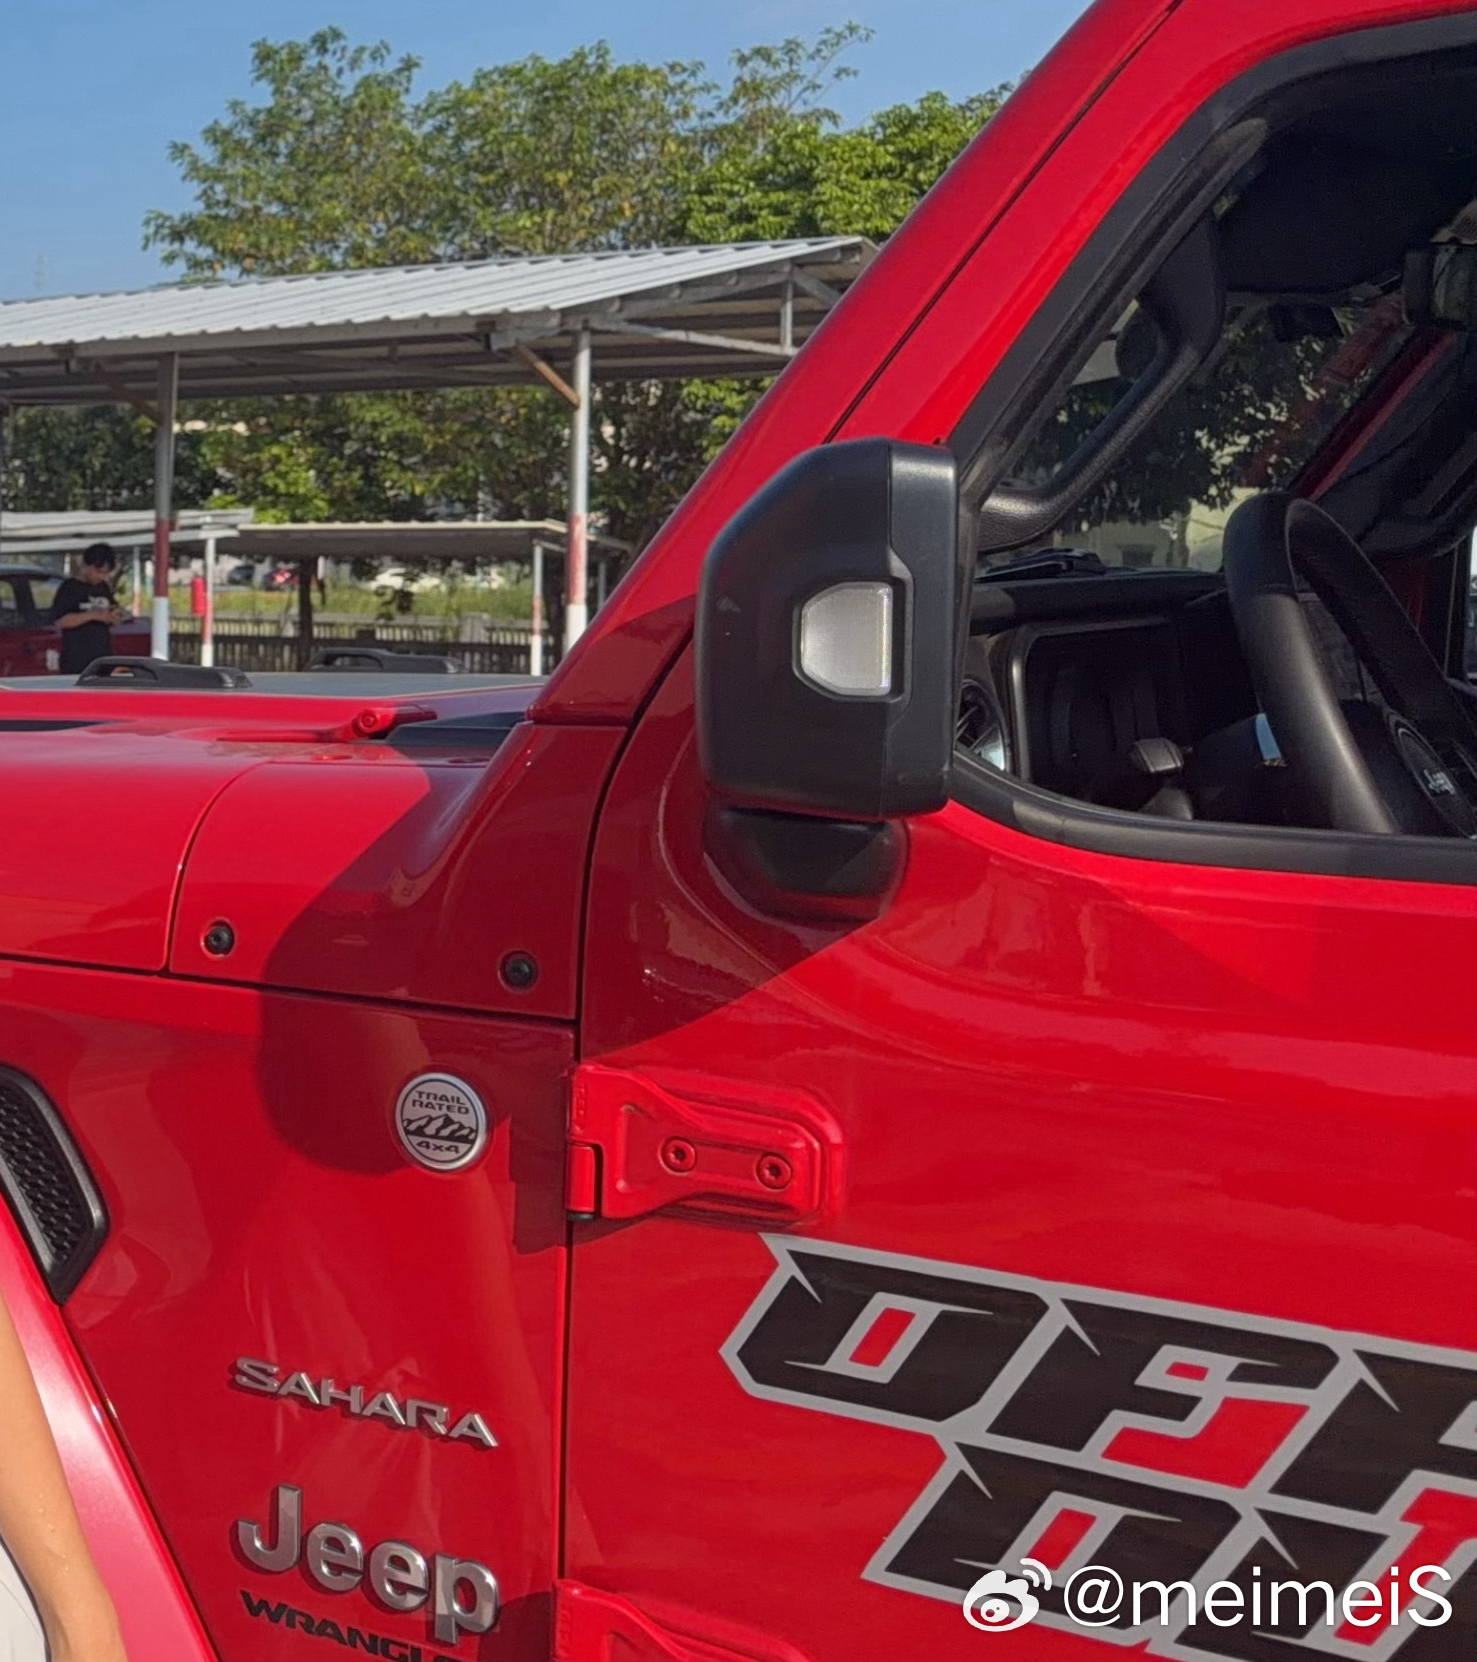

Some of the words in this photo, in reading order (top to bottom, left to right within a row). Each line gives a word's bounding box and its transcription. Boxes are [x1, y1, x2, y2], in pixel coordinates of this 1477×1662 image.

[411, 1099, 470, 1115] RATED
[415, 1090, 466, 1106] TRAIL
[234, 1356, 499, 1447] SAHARA
[237, 1483, 500, 1645] Jeep
